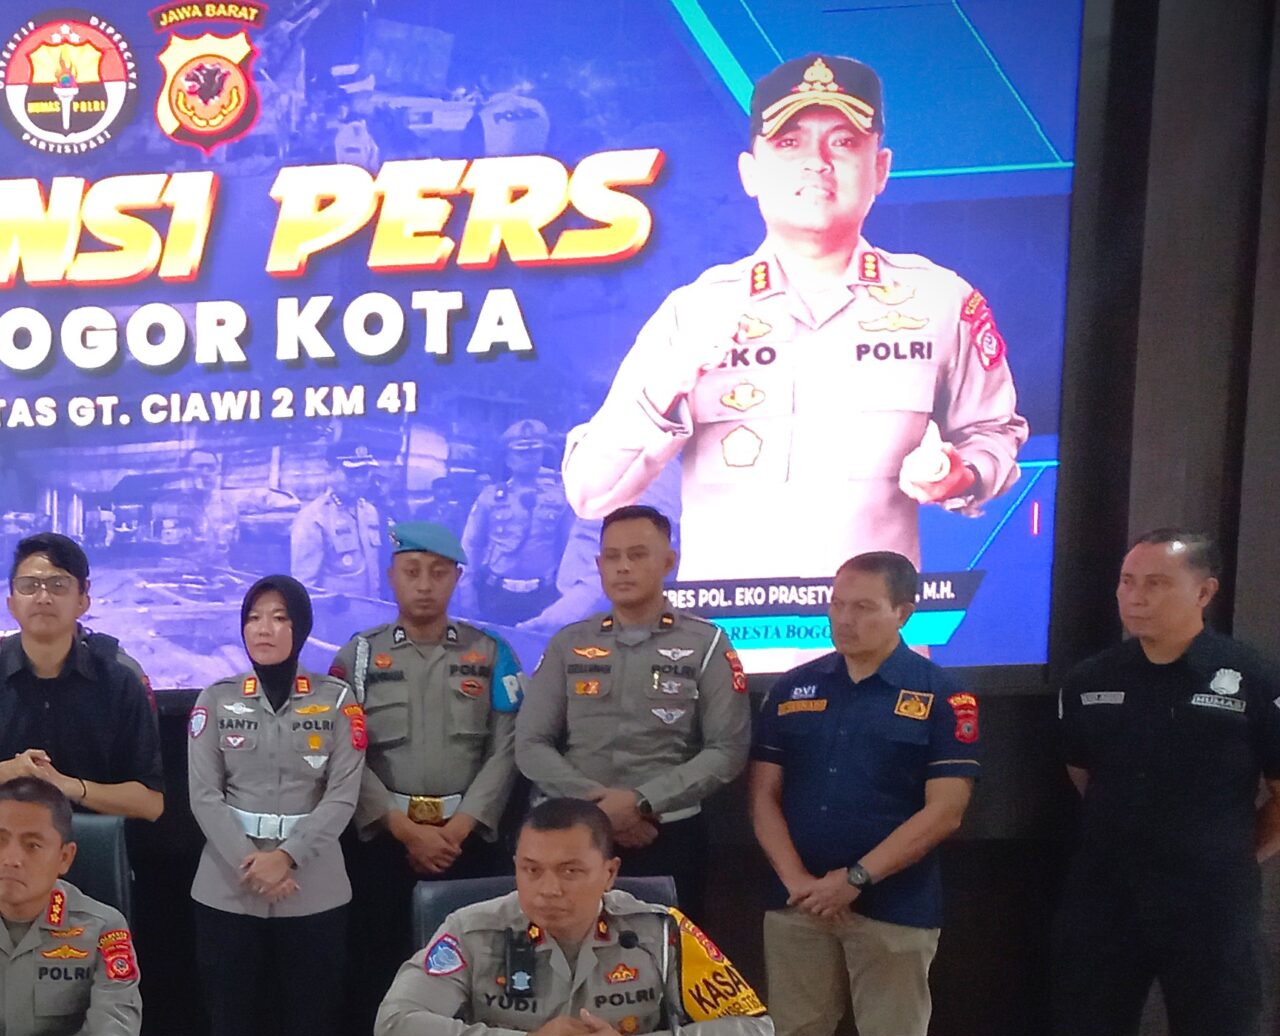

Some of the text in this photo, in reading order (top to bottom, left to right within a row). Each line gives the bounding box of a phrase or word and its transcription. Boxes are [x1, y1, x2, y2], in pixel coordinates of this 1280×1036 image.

[160, 5, 258, 26] JAWA BARAT
[73, 100, 105, 112] POLRI
[22, 131, 111, 154] PARTISIPASI
[265, 148, 665, 276] PERS
[276, 288, 533, 362] KOTA
[855, 341, 933, 362] POLRI
[68, 395, 130, 427] GT.
[140, 388, 261, 424] CIAWI
[271, 387, 295, 419] 2
[305, 384, 365, 417] KM
[376, 380, 418, 414] 41
[698, 588, 732, 608] POL.
[734, 586, 766, 606] EKO
[768, 584, 834, 605] PRASETY
[923, 581, 956, 600] M.H.
[220, 719, 258, 730] SANTI
[292, 718, 334, 731] POLRI
[39, 966, 91, 981] POLRI
[484, 993, 537, 1014] YUDI
[593, 988, 655, 1009] POLRI
